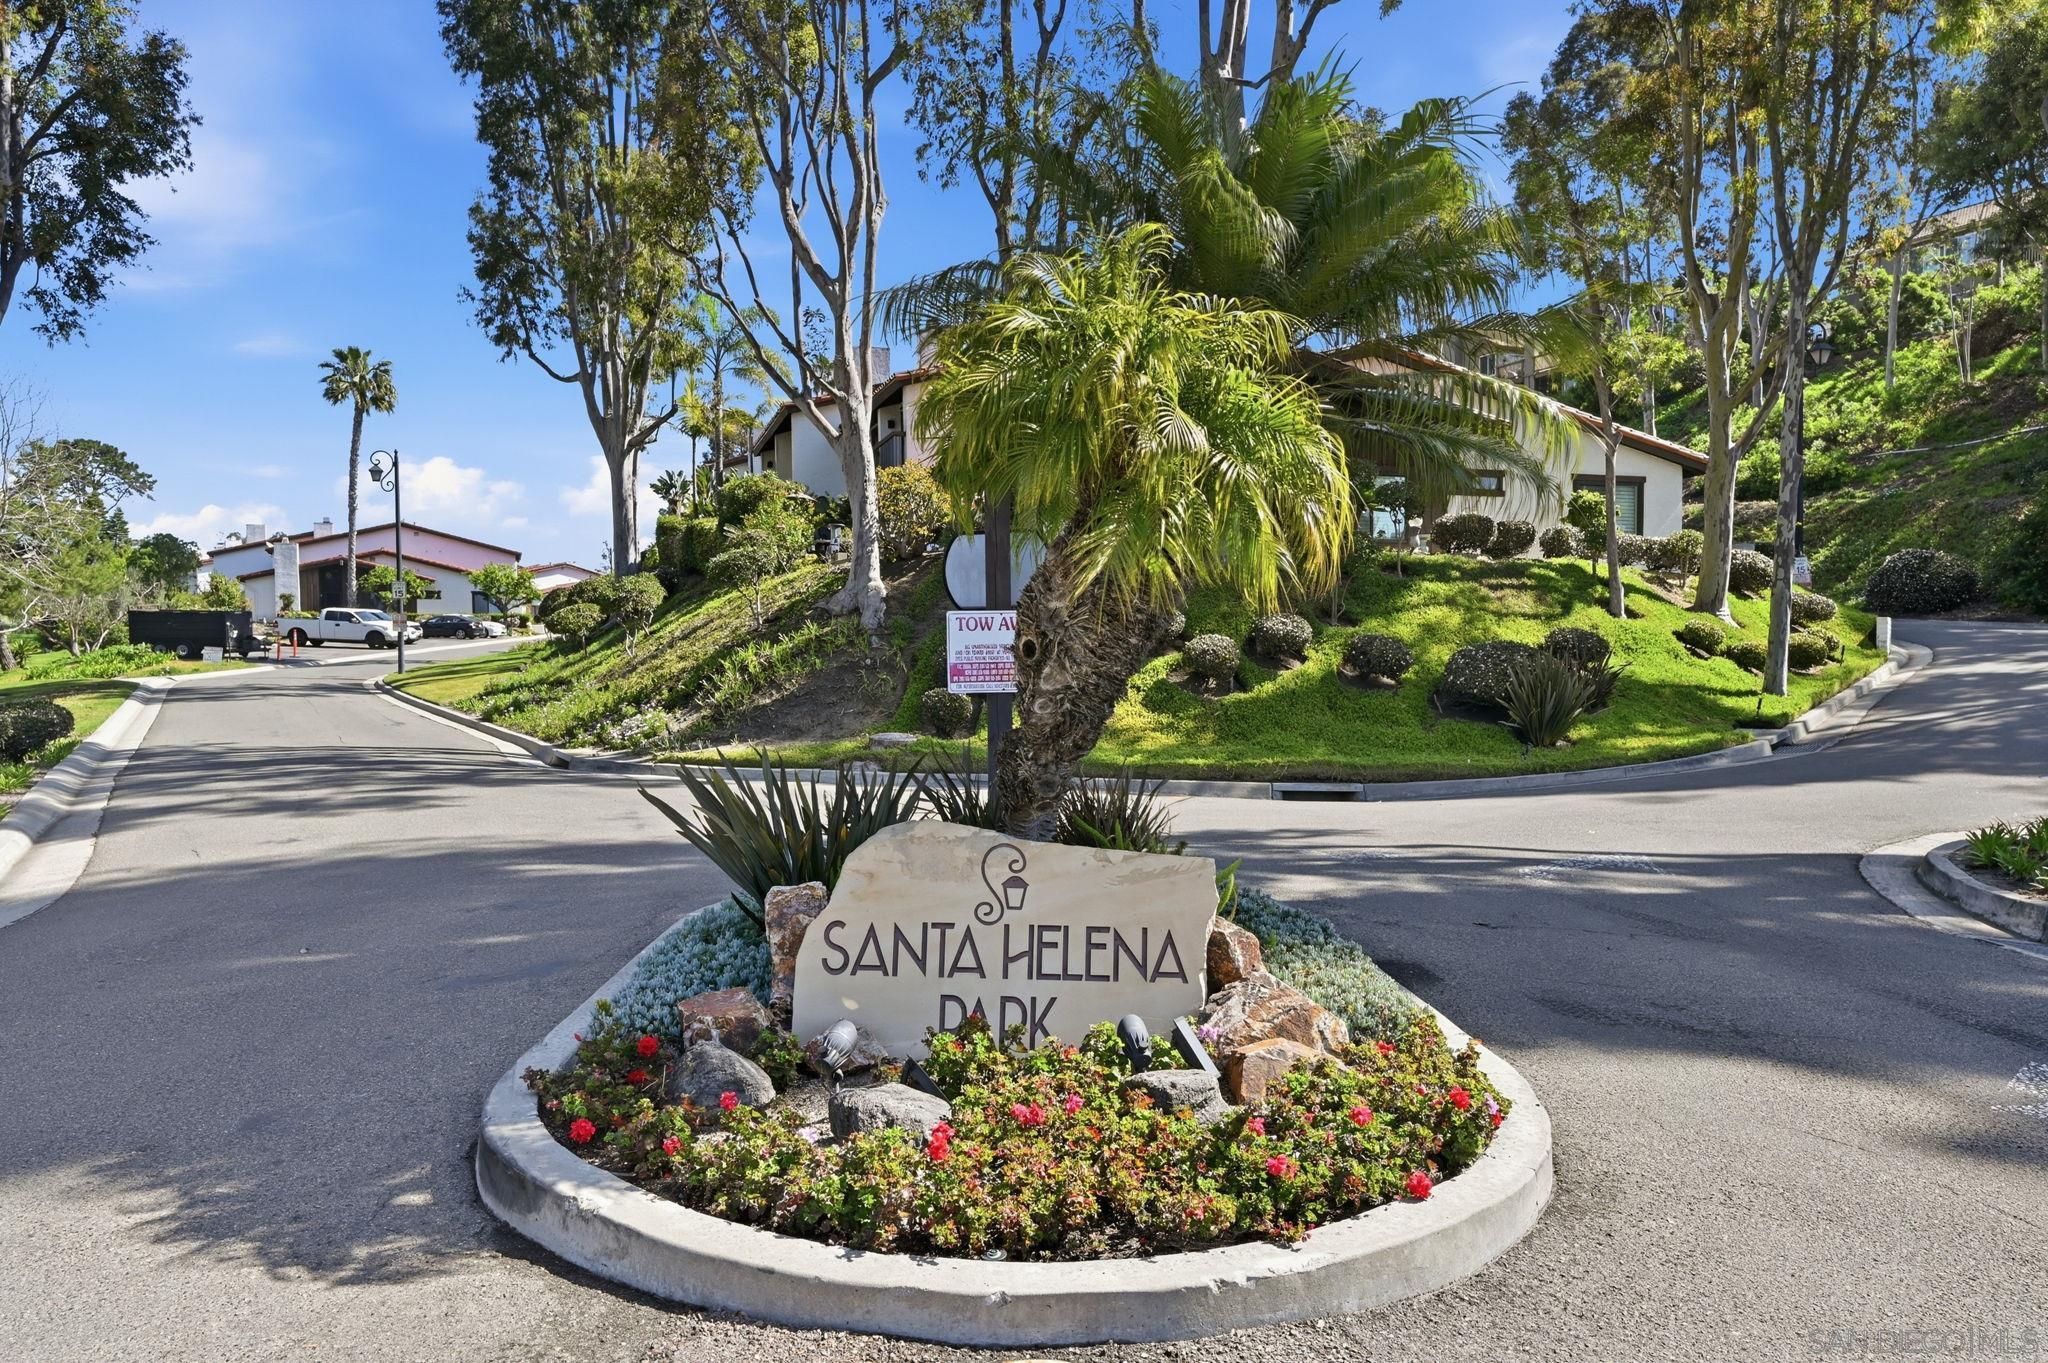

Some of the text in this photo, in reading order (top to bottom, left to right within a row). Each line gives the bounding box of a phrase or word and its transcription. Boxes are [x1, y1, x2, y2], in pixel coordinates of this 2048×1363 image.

[1796, 566, 1806, 574] 15
[394, 590, 404, 598] 15
[955, 616, 994, 632] TOW
[821, 919, 1189, 984] SANTA HELENA
